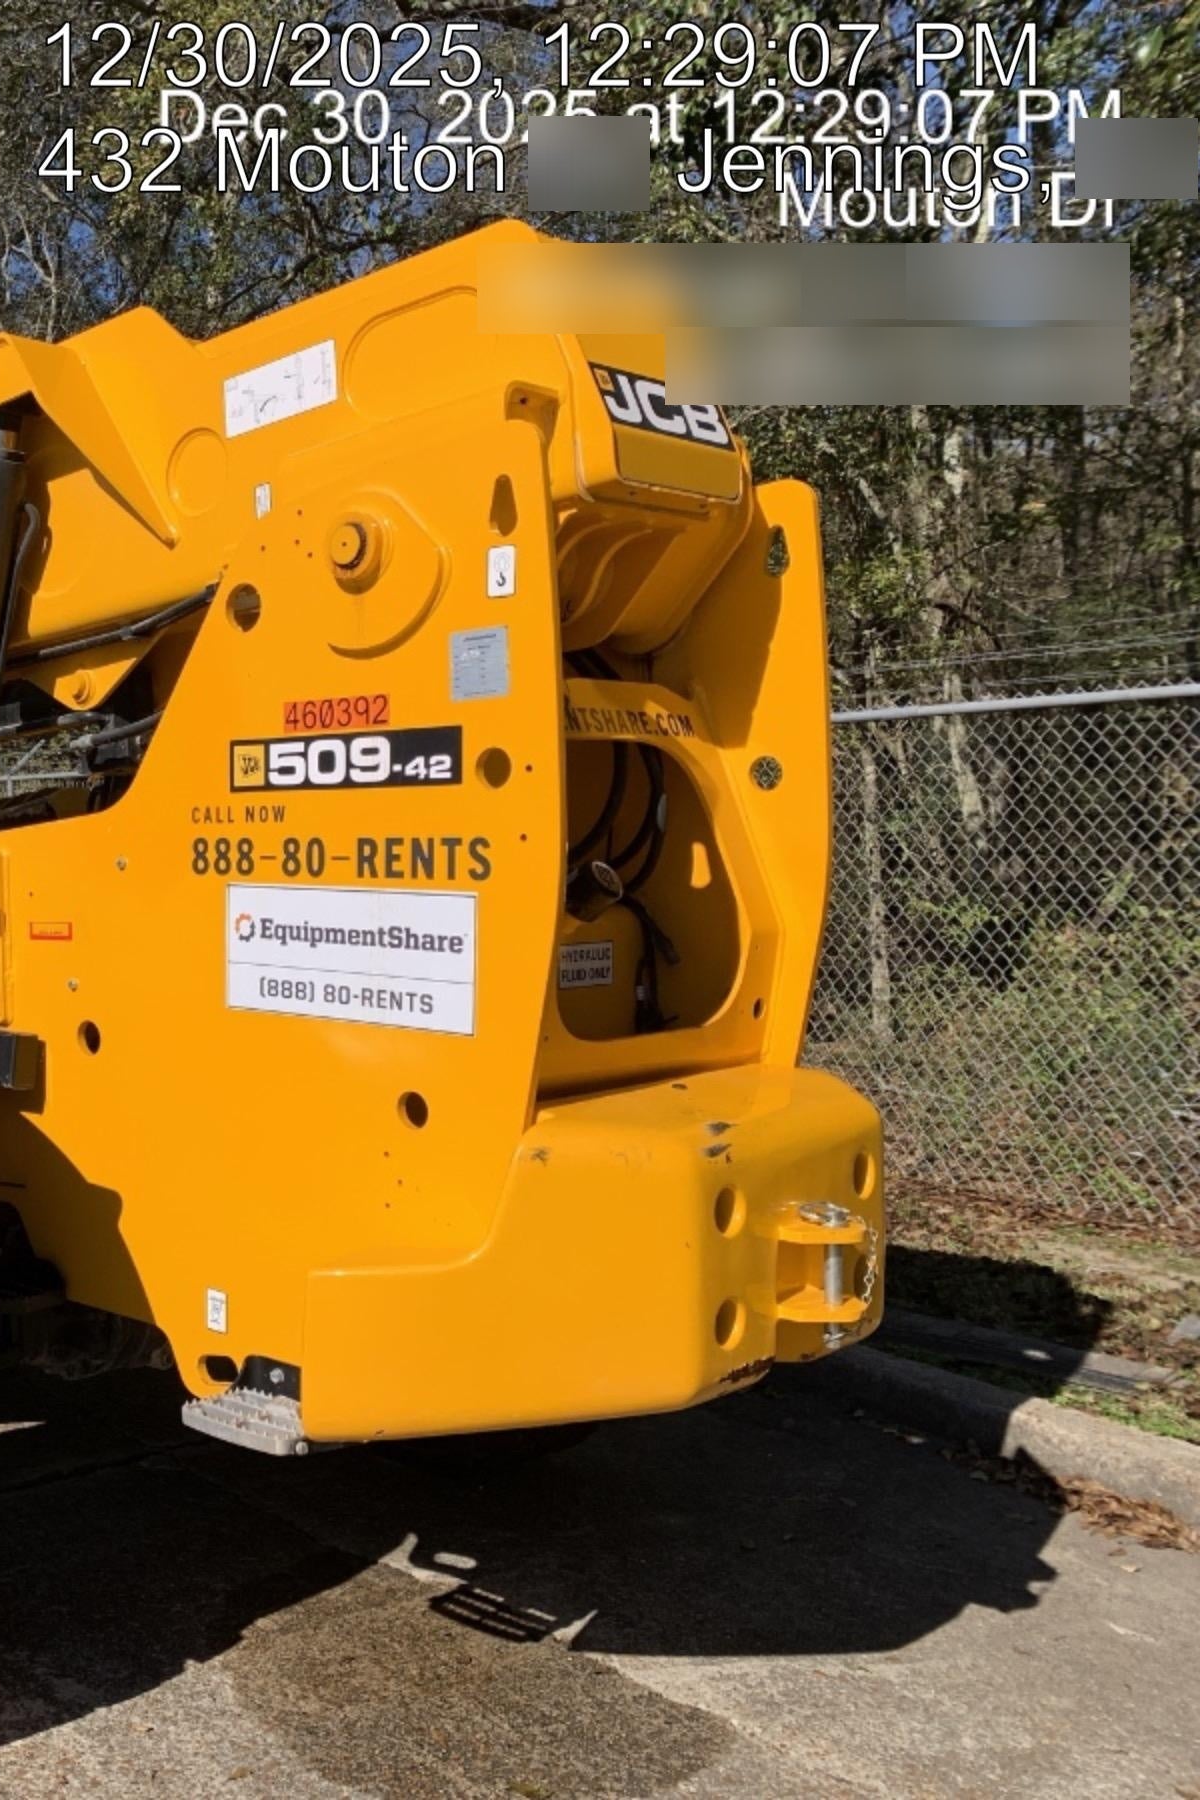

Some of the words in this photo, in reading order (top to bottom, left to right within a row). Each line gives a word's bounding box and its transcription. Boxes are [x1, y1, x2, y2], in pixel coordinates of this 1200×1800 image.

[604, 373, 730, 445] JCB
[285, 694, 389, 730] 460392
[268, 736, 452, 785] 509-42
[192, 807, 234, 824] CALL
[245, 806, 286, 823] NOW
[192, 837, 492, 881] 888-80-RENTS
[260, 918, 464, 953] EquipmentShare
[259, 976, 315, 1002] (888)
[324, 983, 434, 1014] 80-RENTS
